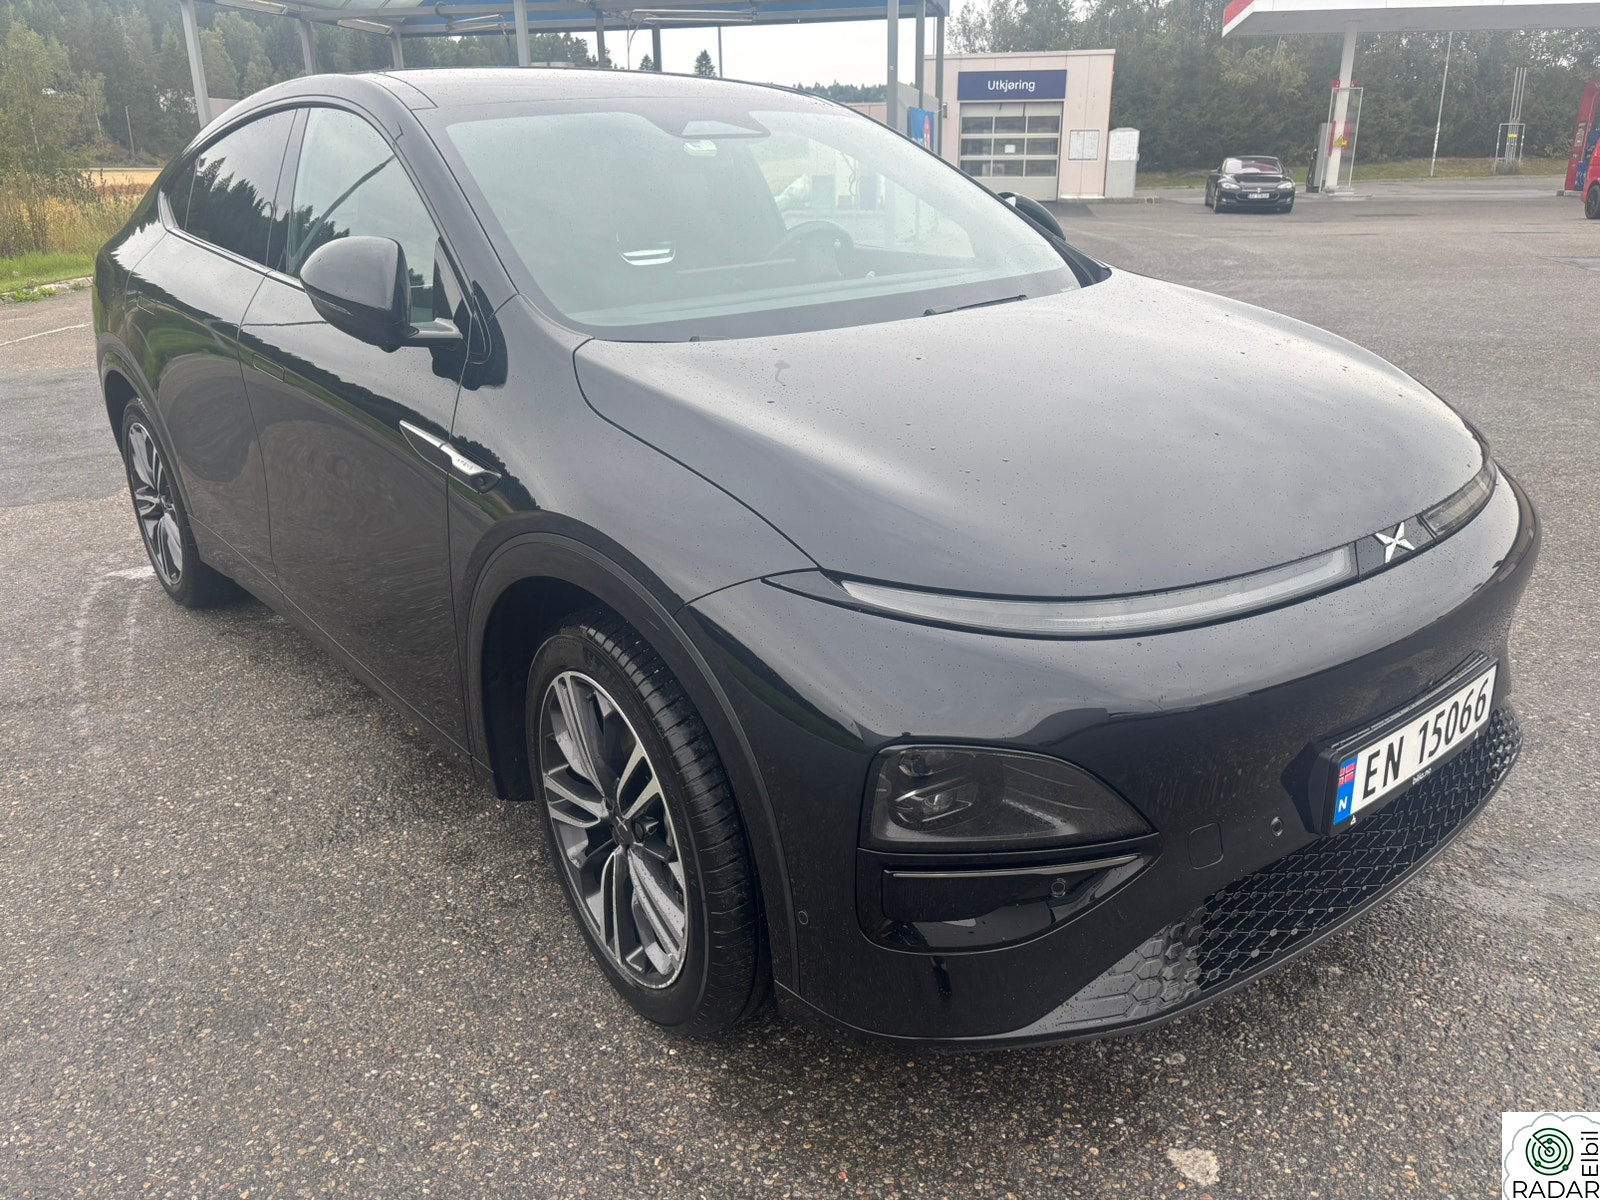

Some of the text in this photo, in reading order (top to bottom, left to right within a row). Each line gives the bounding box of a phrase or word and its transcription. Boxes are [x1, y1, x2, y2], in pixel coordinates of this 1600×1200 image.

[987, 79, 1036, 93] Utkjøring
[1362, 677, 1489, 800] EN 15066
[1338, 796, 1348, 813] N
